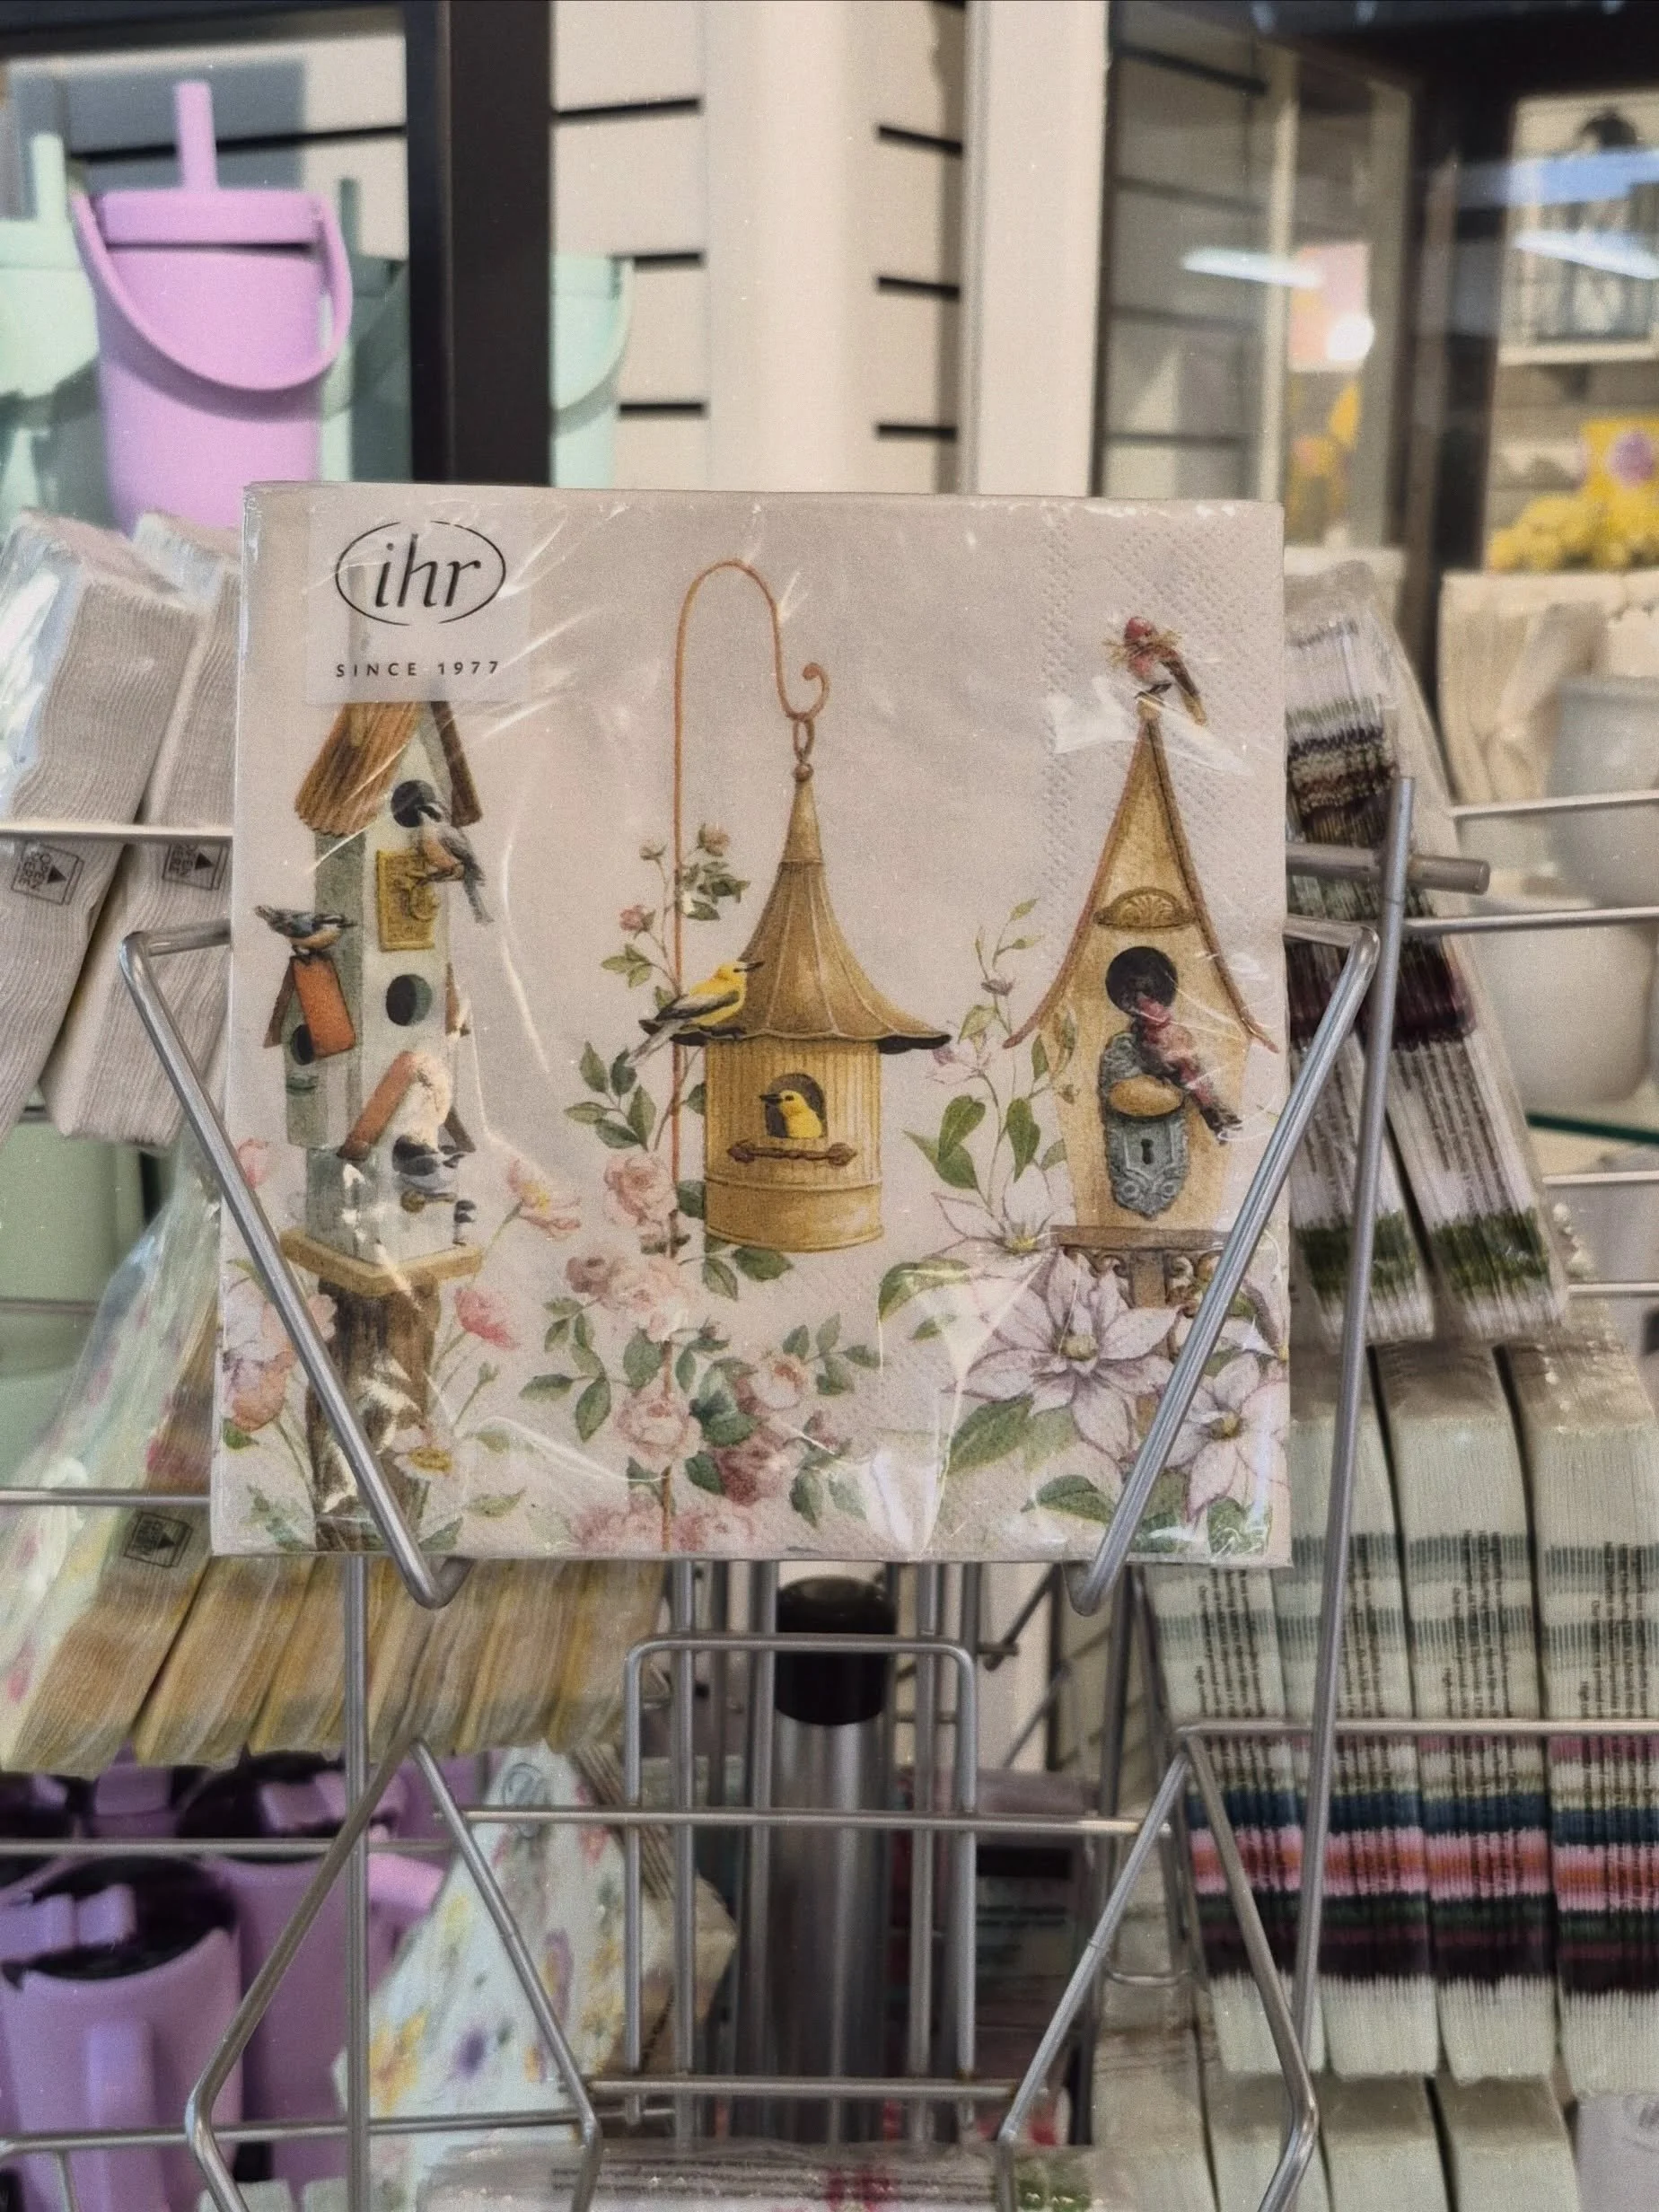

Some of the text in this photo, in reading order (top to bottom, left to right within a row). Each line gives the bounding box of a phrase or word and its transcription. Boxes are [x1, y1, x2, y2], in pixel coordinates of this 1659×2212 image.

[374, 533, 482, 608] ihr
[336, 661, 498, 678] SINCE 1977
